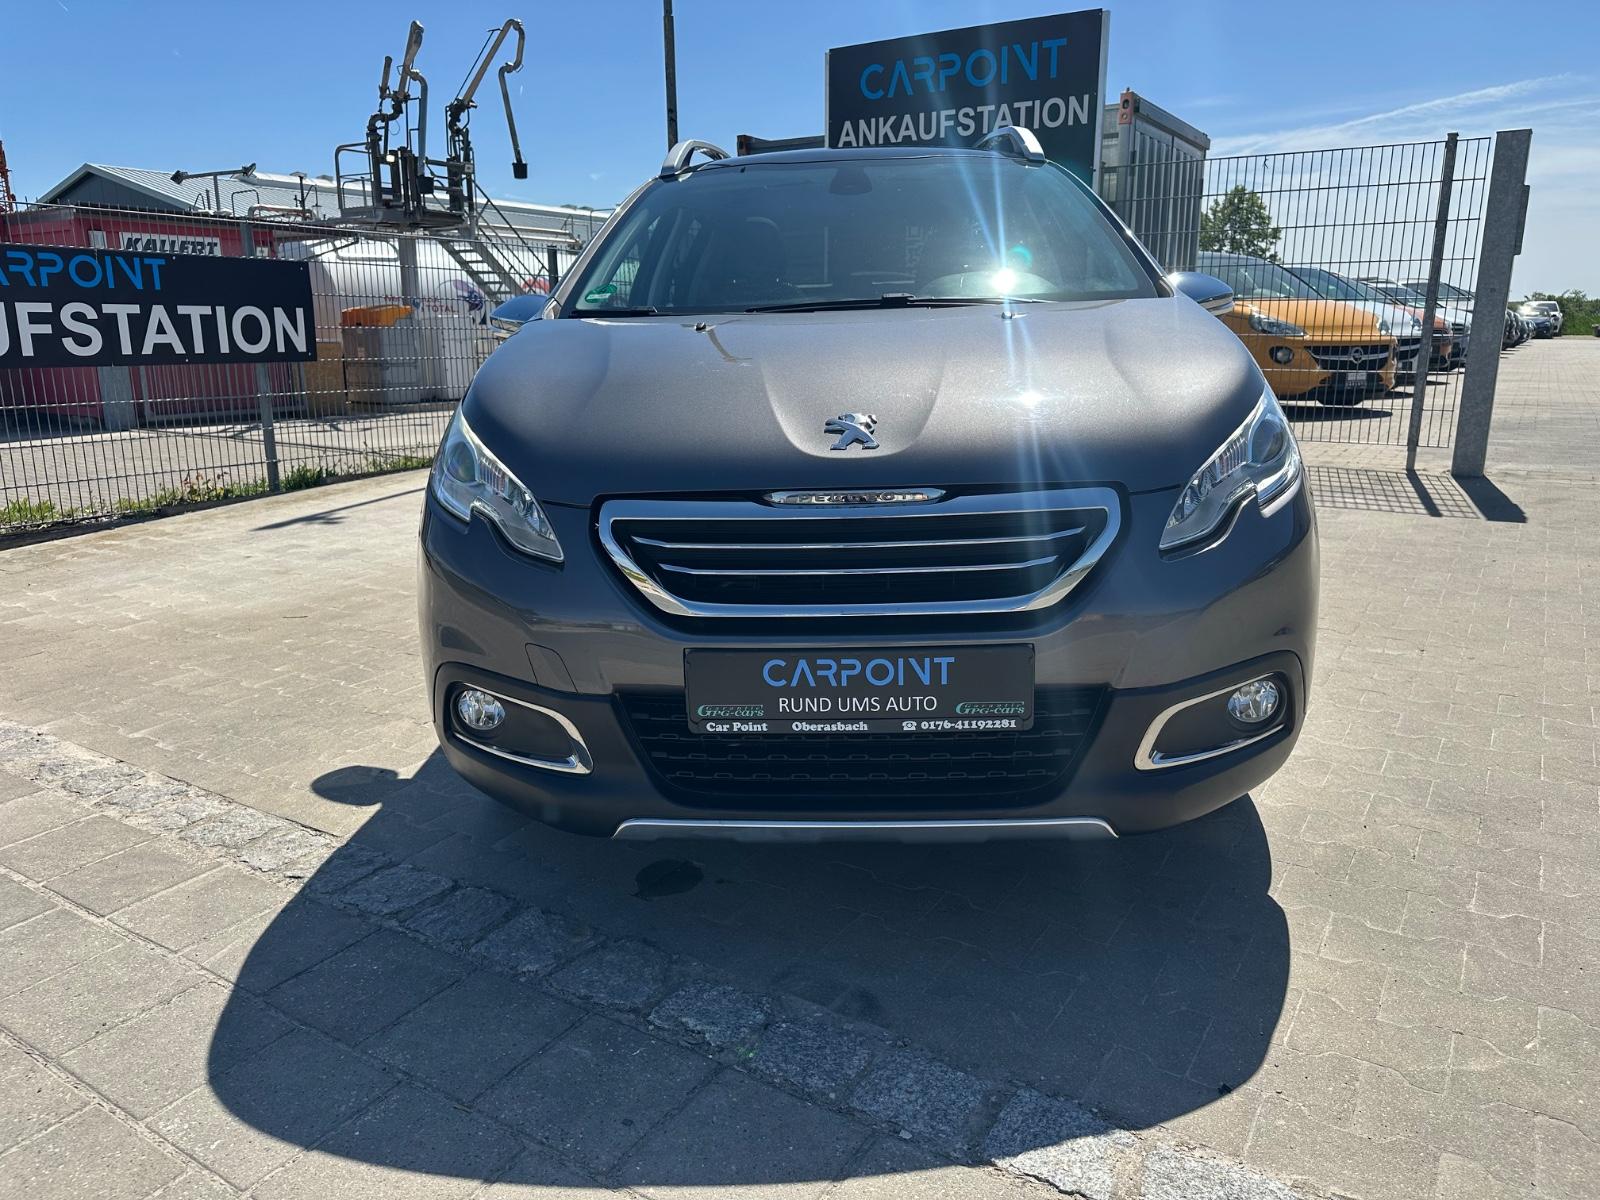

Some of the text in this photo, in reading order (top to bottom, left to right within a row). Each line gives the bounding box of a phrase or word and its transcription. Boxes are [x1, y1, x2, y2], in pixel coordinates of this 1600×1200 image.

[859, 37, 1068, 100] CARPOINT
[837, 94, 1090, 148] ANKAUFSTATION
[762, 656, 955, 688] CARPOINT
[779, 695, 938, 713] RUND UMS AUTO
[706, 721, 768, 732] Car Point
[791, 719, 869, 732] Oberasbach
[920, 719, 1017, 731] 0176-41192281
